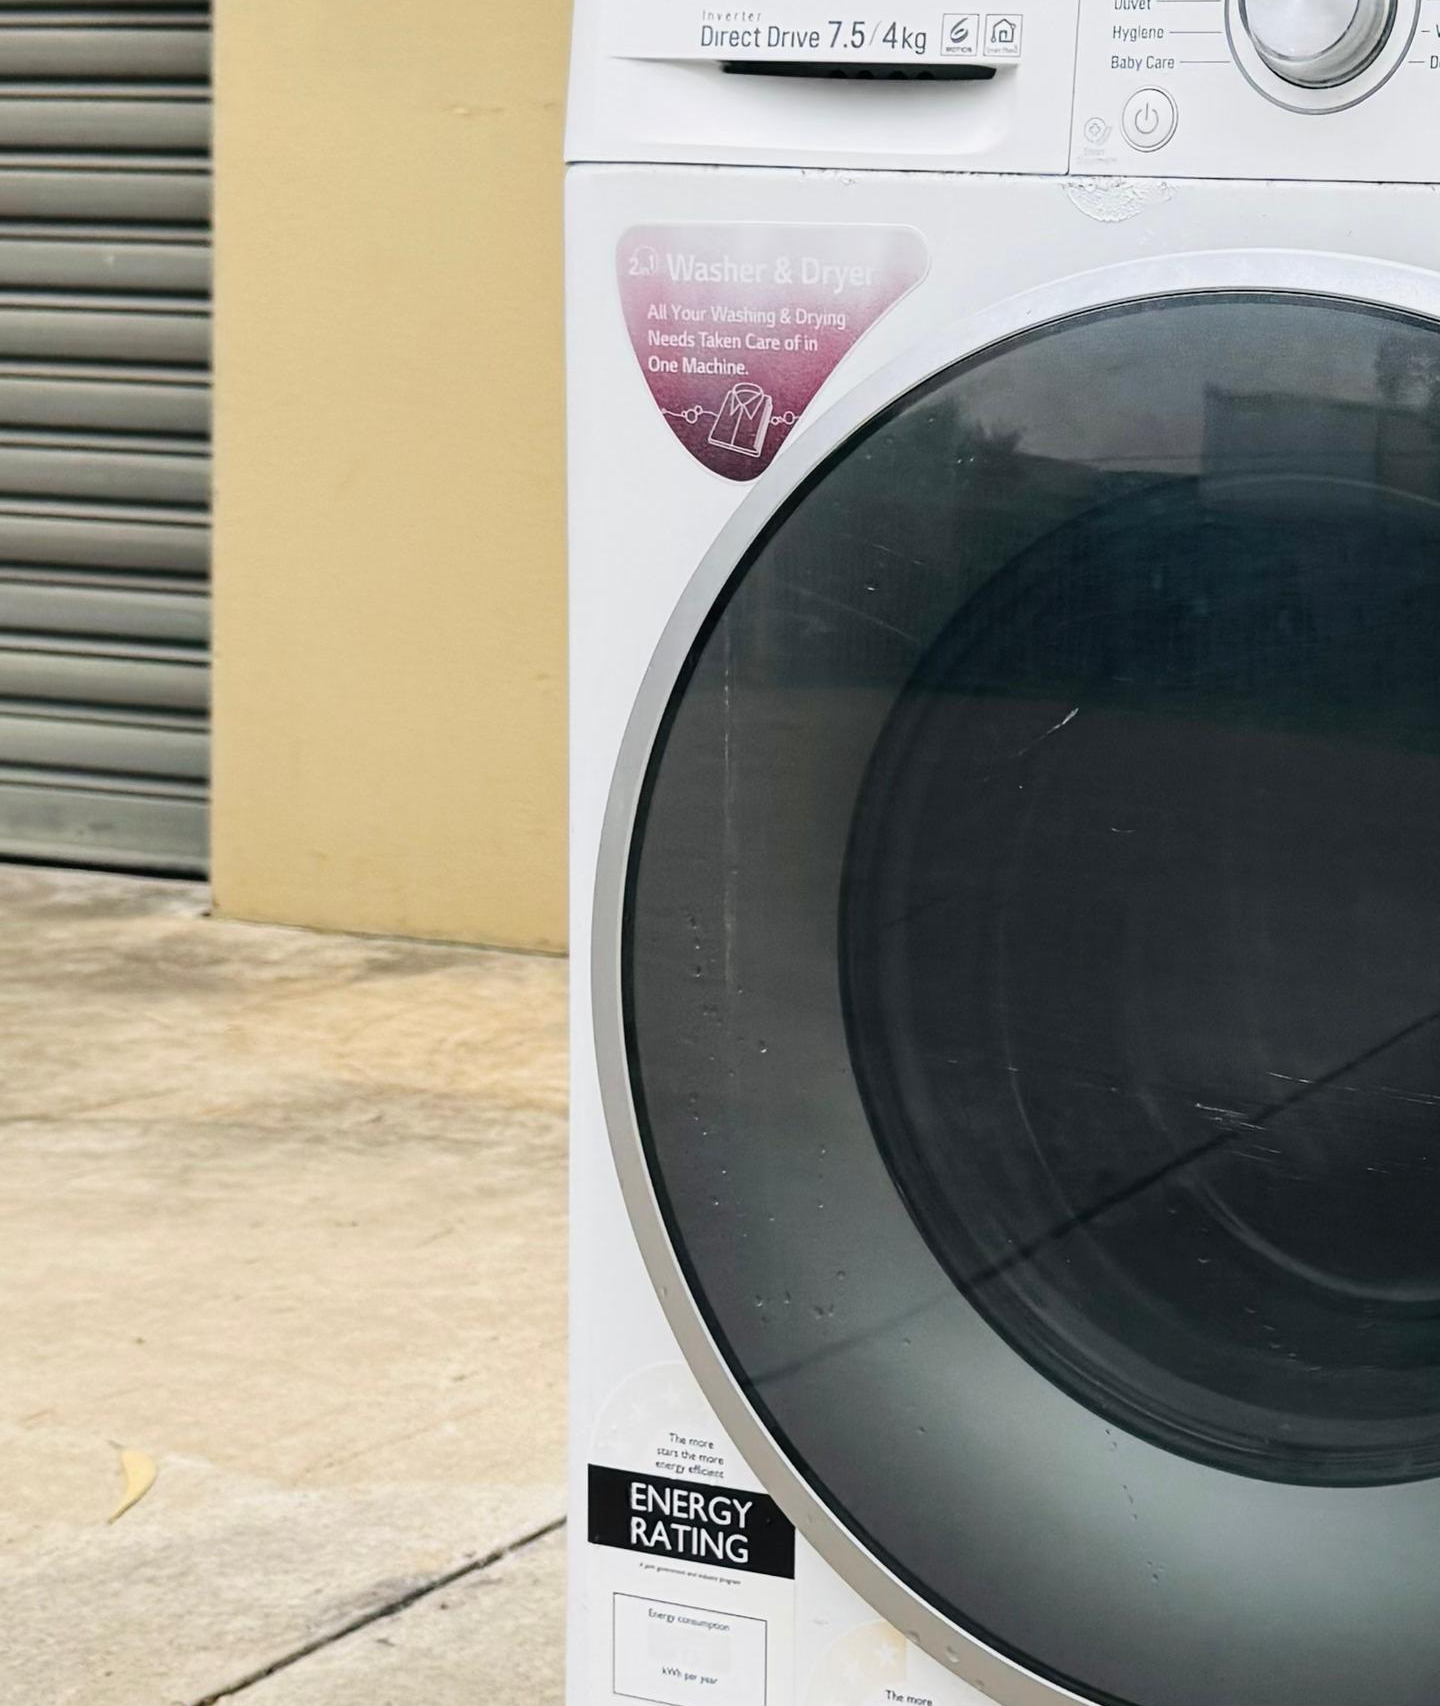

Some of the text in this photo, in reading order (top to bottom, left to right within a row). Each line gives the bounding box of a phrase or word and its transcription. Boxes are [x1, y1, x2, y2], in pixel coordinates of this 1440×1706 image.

[702, 10, 762, 22] Inverter
[700, 25, 760, 49] Direct
[767, 25, 820, 49] Drive
[1112, 25, 1164, 43] Hygiene
[1111, 55, 1175, 72] Baby Care
[666, 253, 770, 284] Washer
[773, 257, 793, 285] &
[802, 258, 874, 293] Dryer
[648, 305, 847, 329] All Your Washing & Drying
[648, 330, 818, 352] Needs Taken Care of in
[648, 355, 749, 375] One Machine.
[669, 1432, 714, 1449] The more
[657, 1448, 724, 1465] stars the more
[630, 1481, 753, 1529] ENERGY
[630, 1516, 749, 1564] RATING
[648, 1608, 730, 1631] Energy consumption
[885, 1689, 932, 1706] The more
